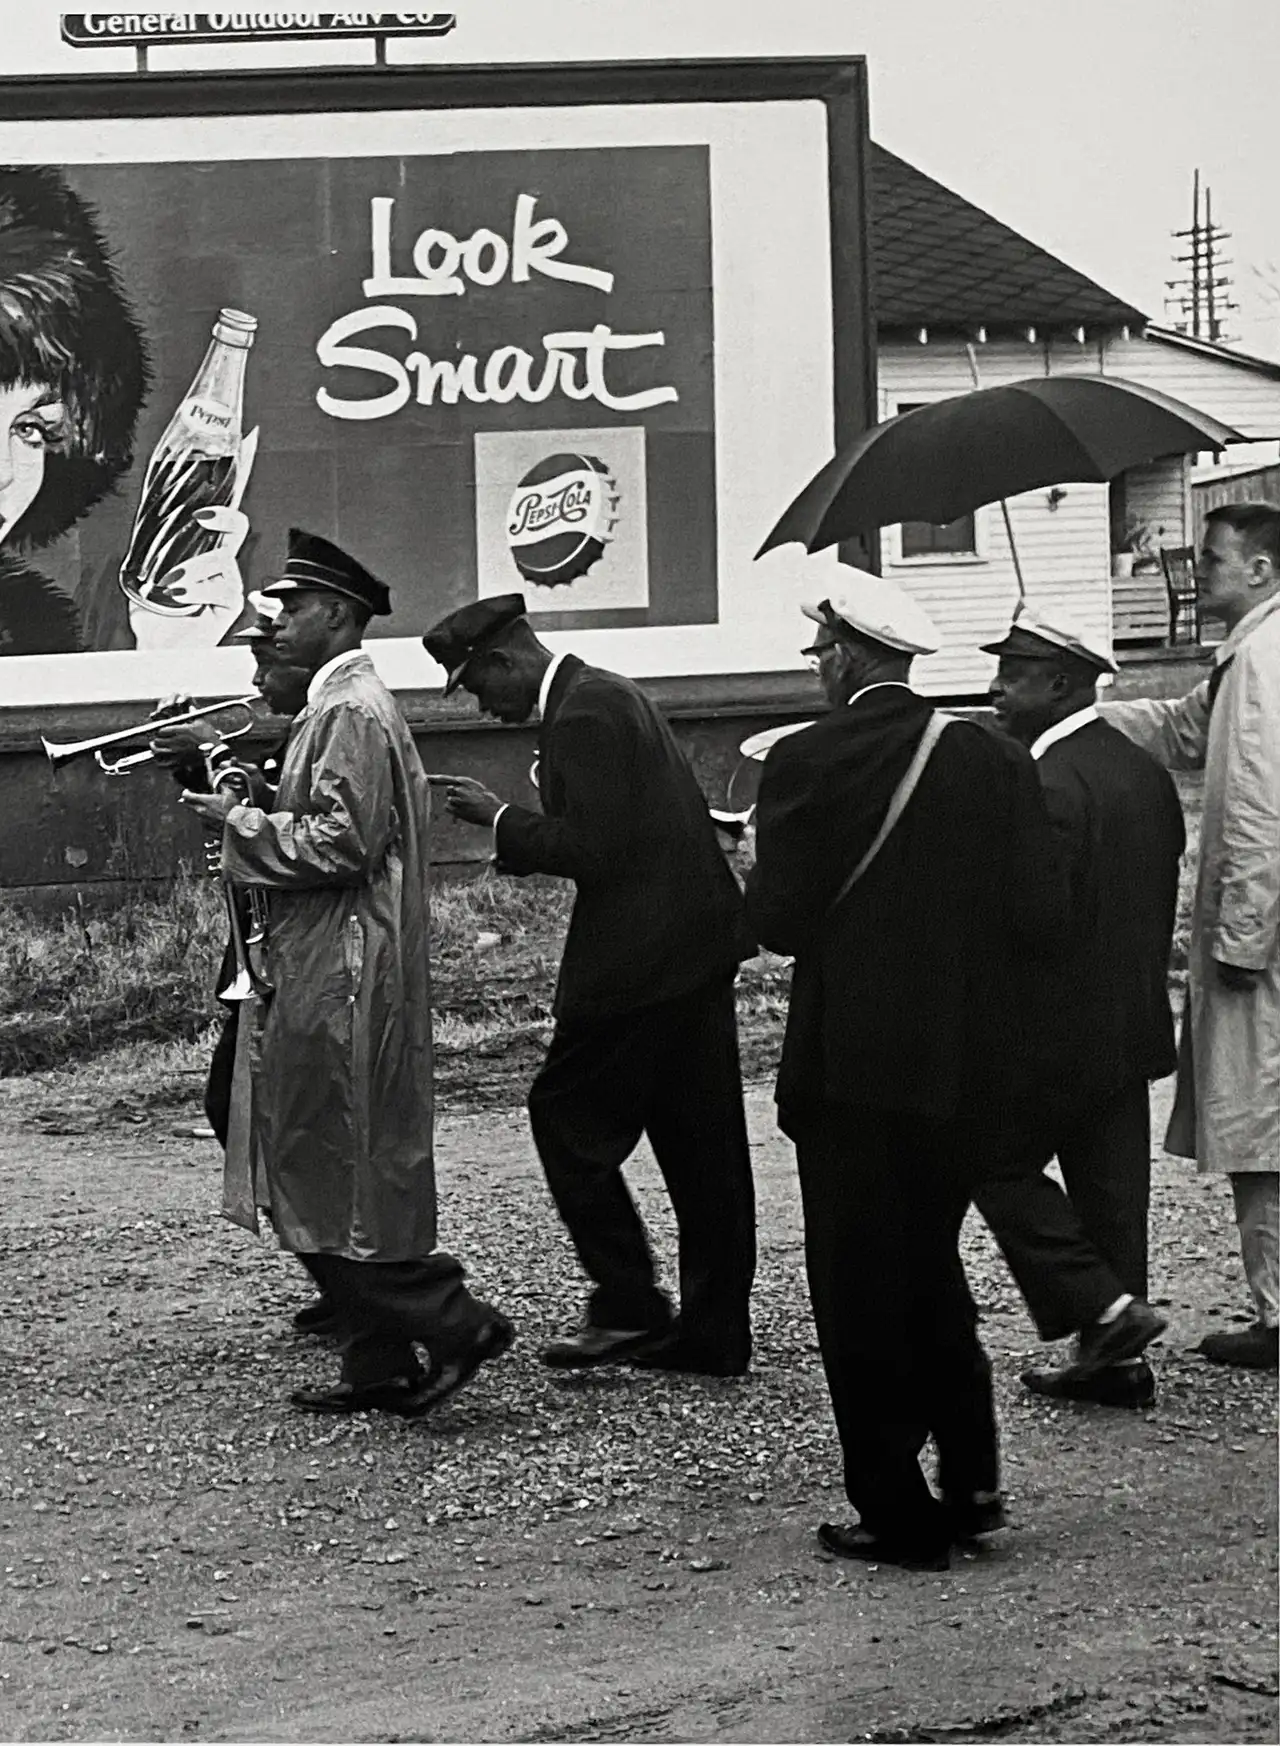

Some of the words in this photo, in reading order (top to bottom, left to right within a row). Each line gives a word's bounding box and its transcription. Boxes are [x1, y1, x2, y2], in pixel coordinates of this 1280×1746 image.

[83, 13, 197, 34] General
[362, 194, 615, 298] Look
[316, 305, 679, 420] Smart
